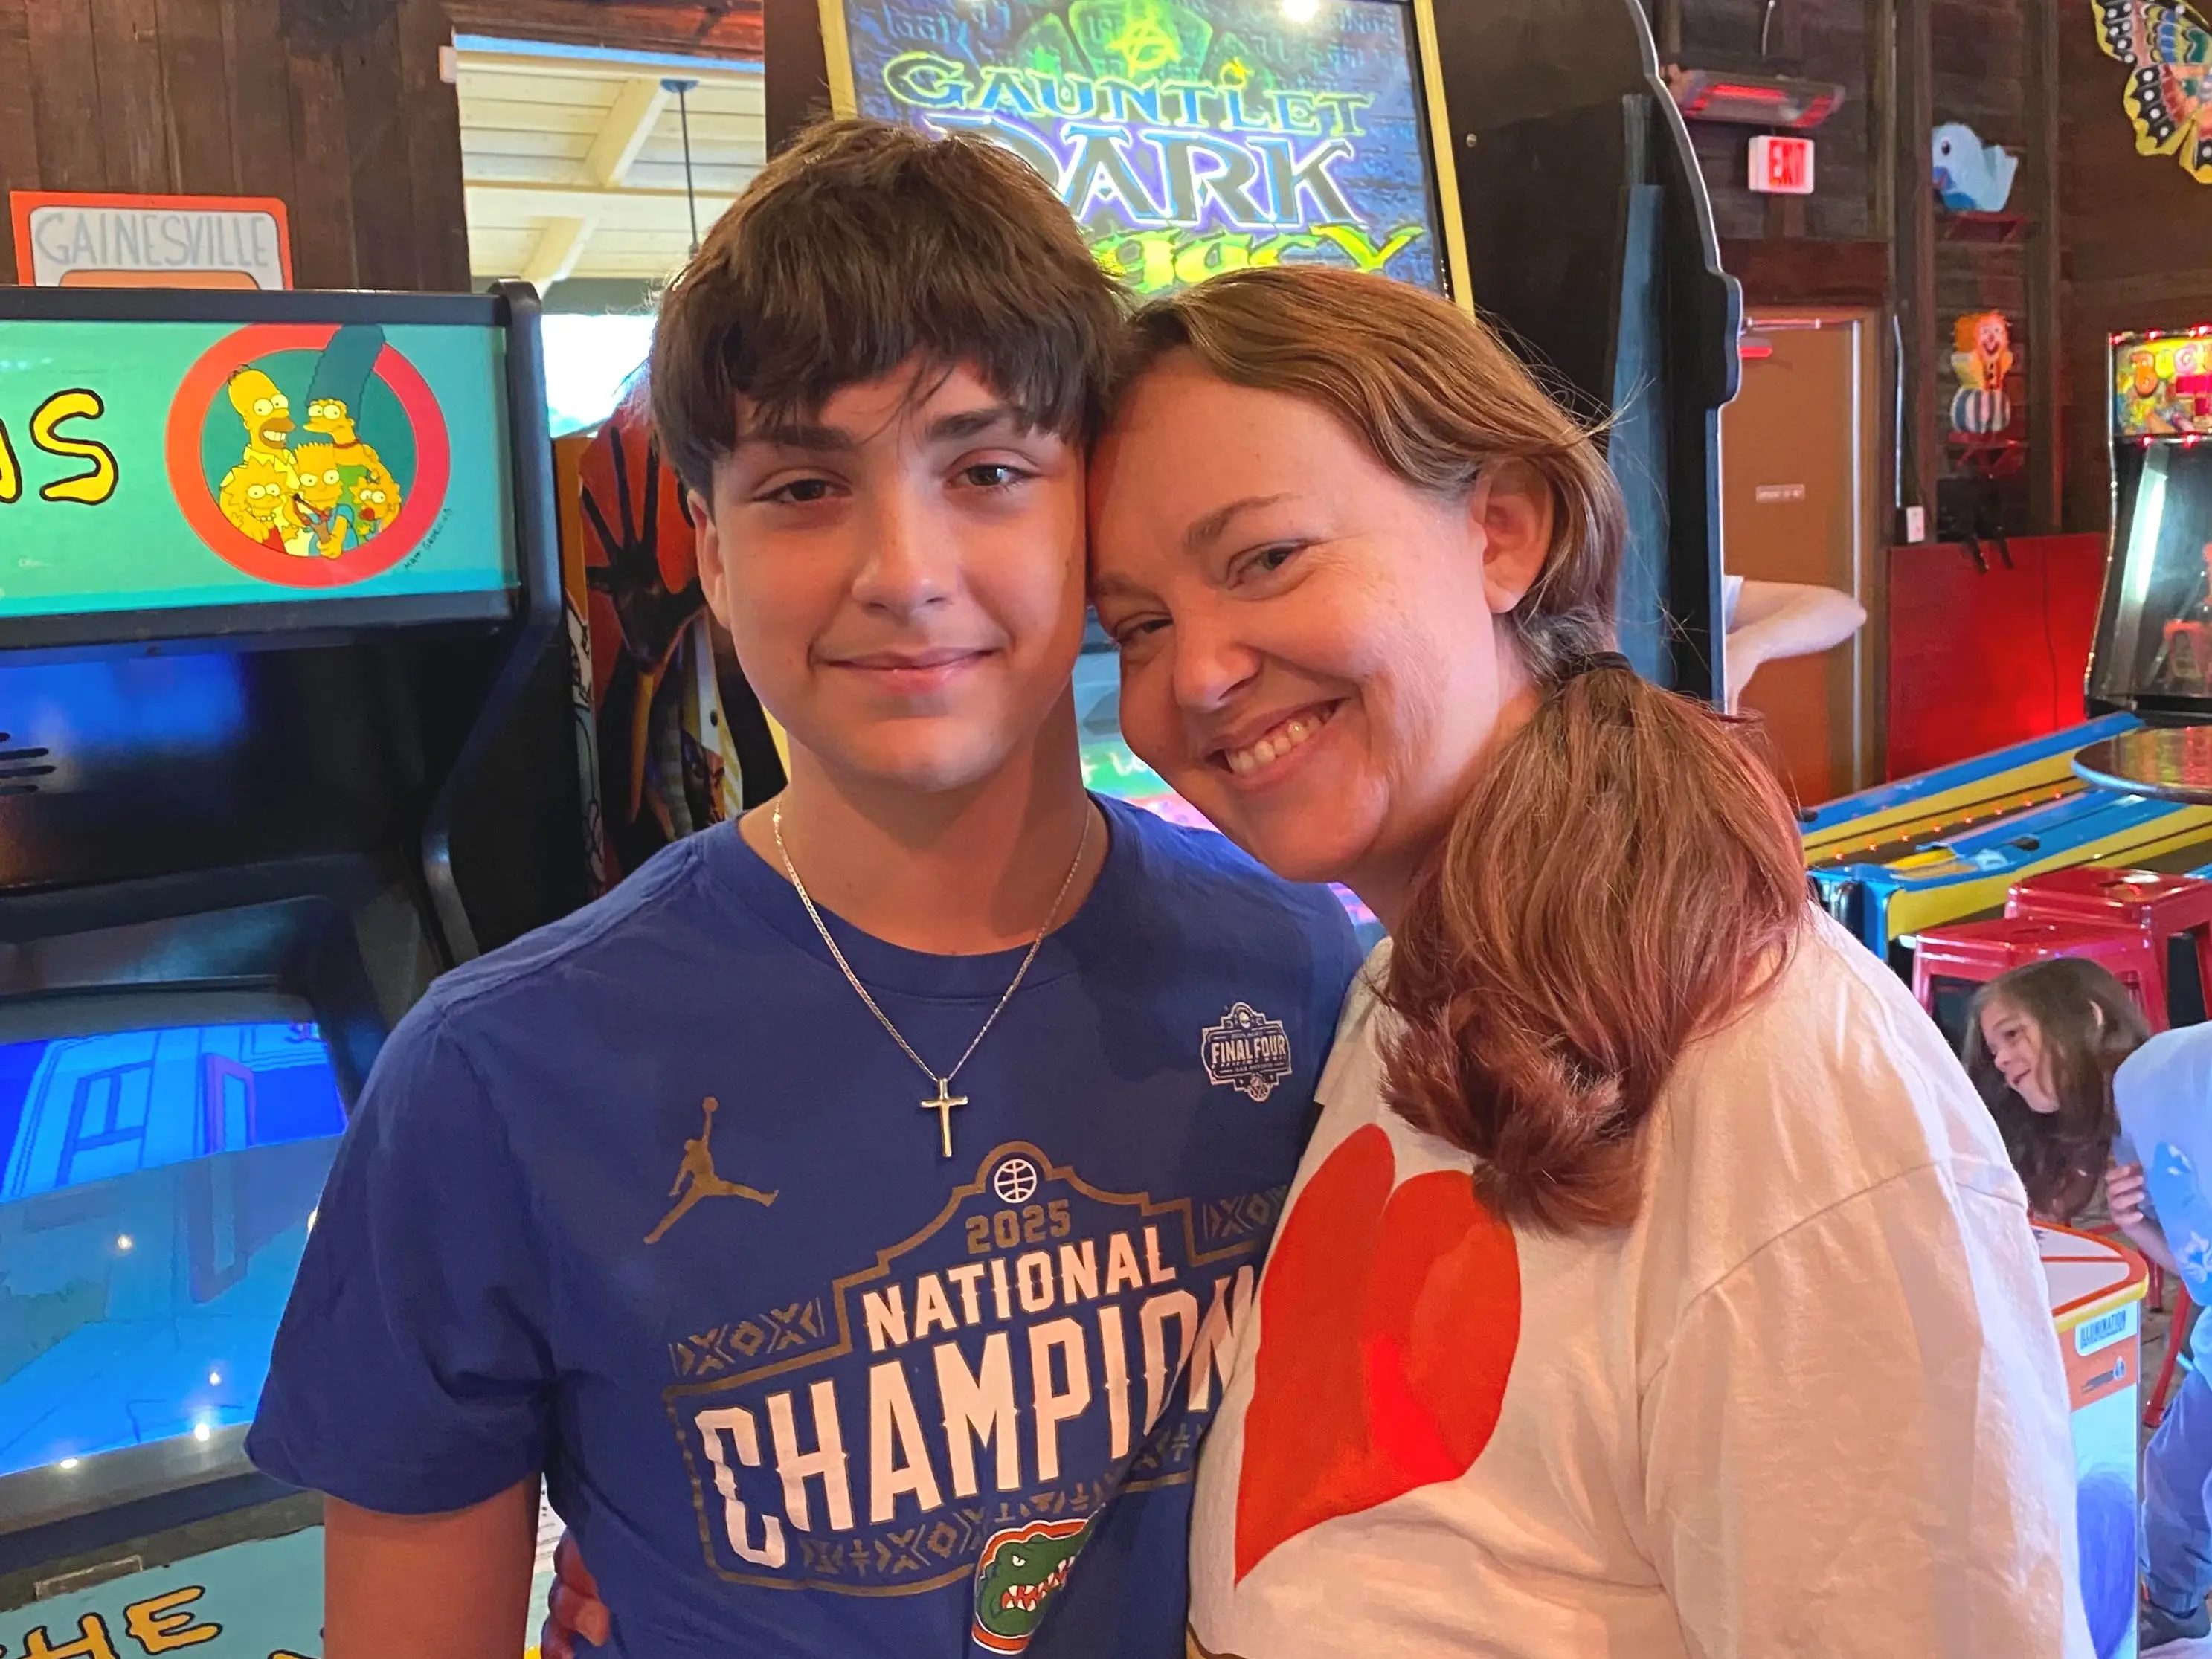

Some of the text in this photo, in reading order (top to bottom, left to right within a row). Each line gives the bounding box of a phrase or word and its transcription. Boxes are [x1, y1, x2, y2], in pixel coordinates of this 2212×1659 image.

[883, 52, 1375, 137] GAUNTLET
[34, 210, 269, 268] GAINESVILLE
[0, 387, 119, 506] S
[1211, 1034, 1287, 1069] FINAL FOUR
[965, 1199, 1071, 1254] 2025
[862, 1226, 1177, 1354] NATIONAL
[0, 1585, 222, 1659] HE
